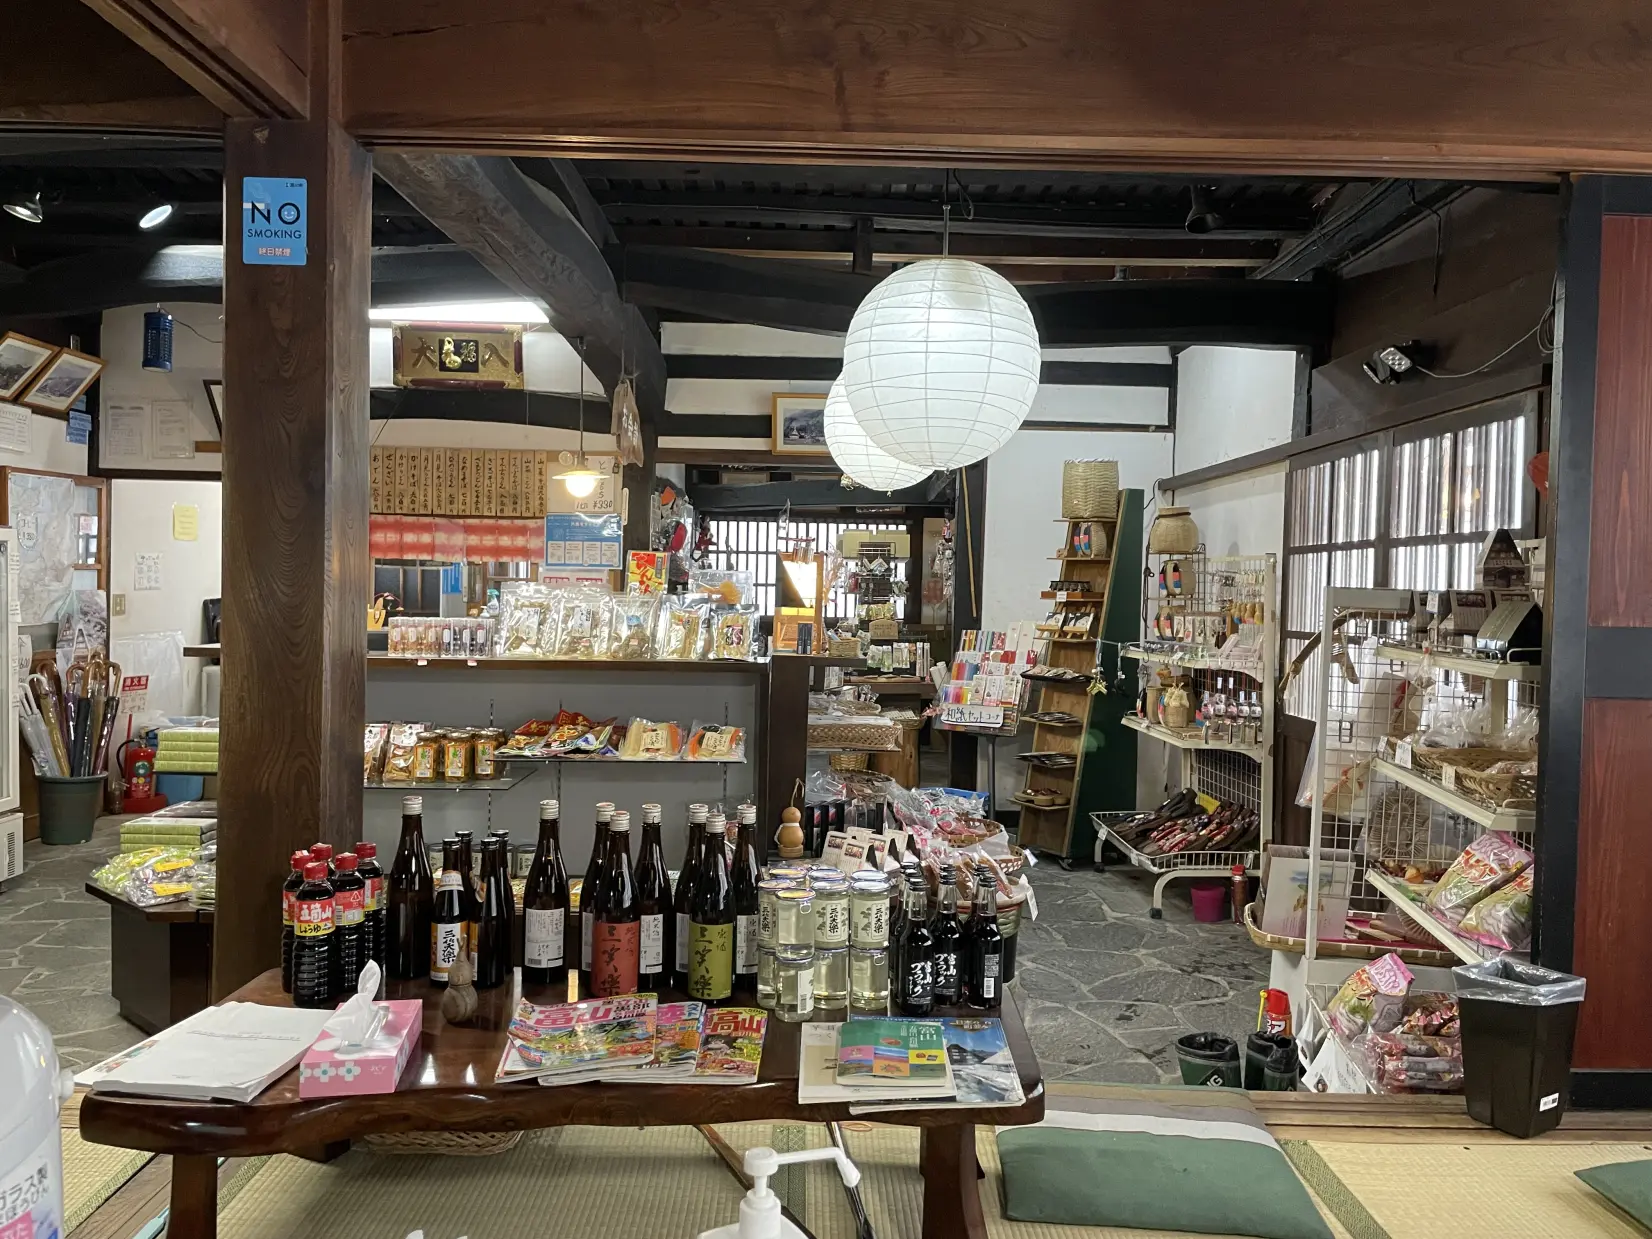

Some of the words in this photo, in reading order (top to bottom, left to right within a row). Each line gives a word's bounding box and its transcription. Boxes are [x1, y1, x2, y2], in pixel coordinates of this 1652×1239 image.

[251, 201, 301, 226] NO
[247, 228, 302, 240] SMOKING
[258, 247, 291, 257] 終日禁煙
[299, 924, 322, 934] しょうゆ
[924, 961, 933, 984] 富山
[935, 953, 948, 987] ブラック
[946, 953, 957, 976] 富山
[910, 961, 925, 998] ブラック
[533, 1006, 613, 1028] 富山
[711, 1010, 762, 1033] 高山
